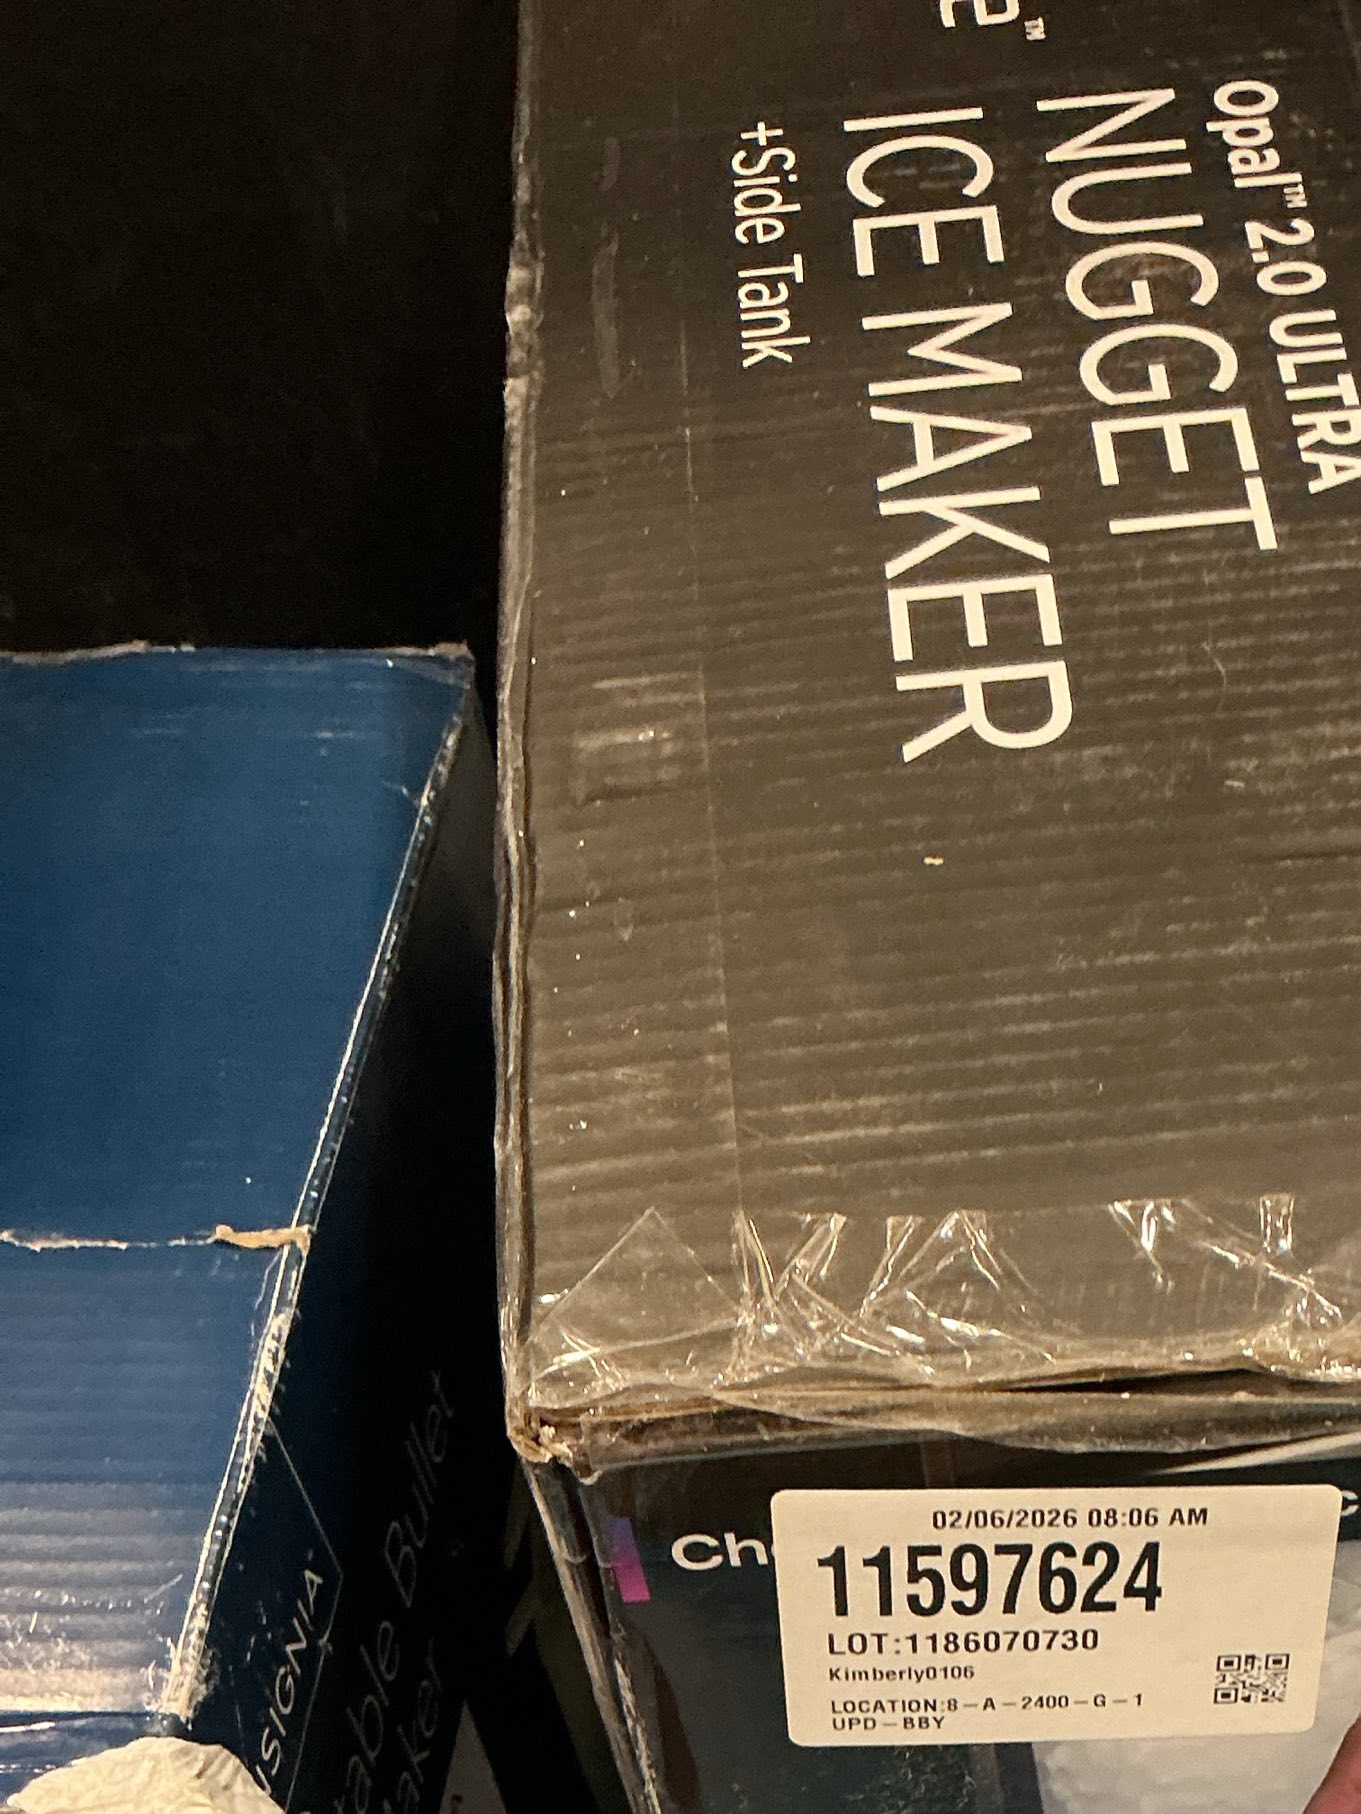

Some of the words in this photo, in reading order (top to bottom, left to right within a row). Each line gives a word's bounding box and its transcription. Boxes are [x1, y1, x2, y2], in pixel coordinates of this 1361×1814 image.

[730, 120, 801, 241] +Side
[842, 107, 1006, 279] ICE
[736, 252, 811, 369] Tank
[1244, 217, 1328, 297] 2.0
[1035, 87, 1279, 551] NUGGET
[861, 302, 1074, 763] MAKER
[383, 1369, 456, 1608] Bullet
[932, 1509, 1078, 1530] 02/06/2026
[1087, 1507, 1159, 1528] 08:06
[1168, 1507, 1209, 1526] AM
[817, 1541, 1162, 1617] 11597624
[257, 1567, 324, 1796] SIGNIA
[828, 1629, 1099, 1656] LOT:1186070730
[829, 1665, 975, 1684] Kimberly0106
